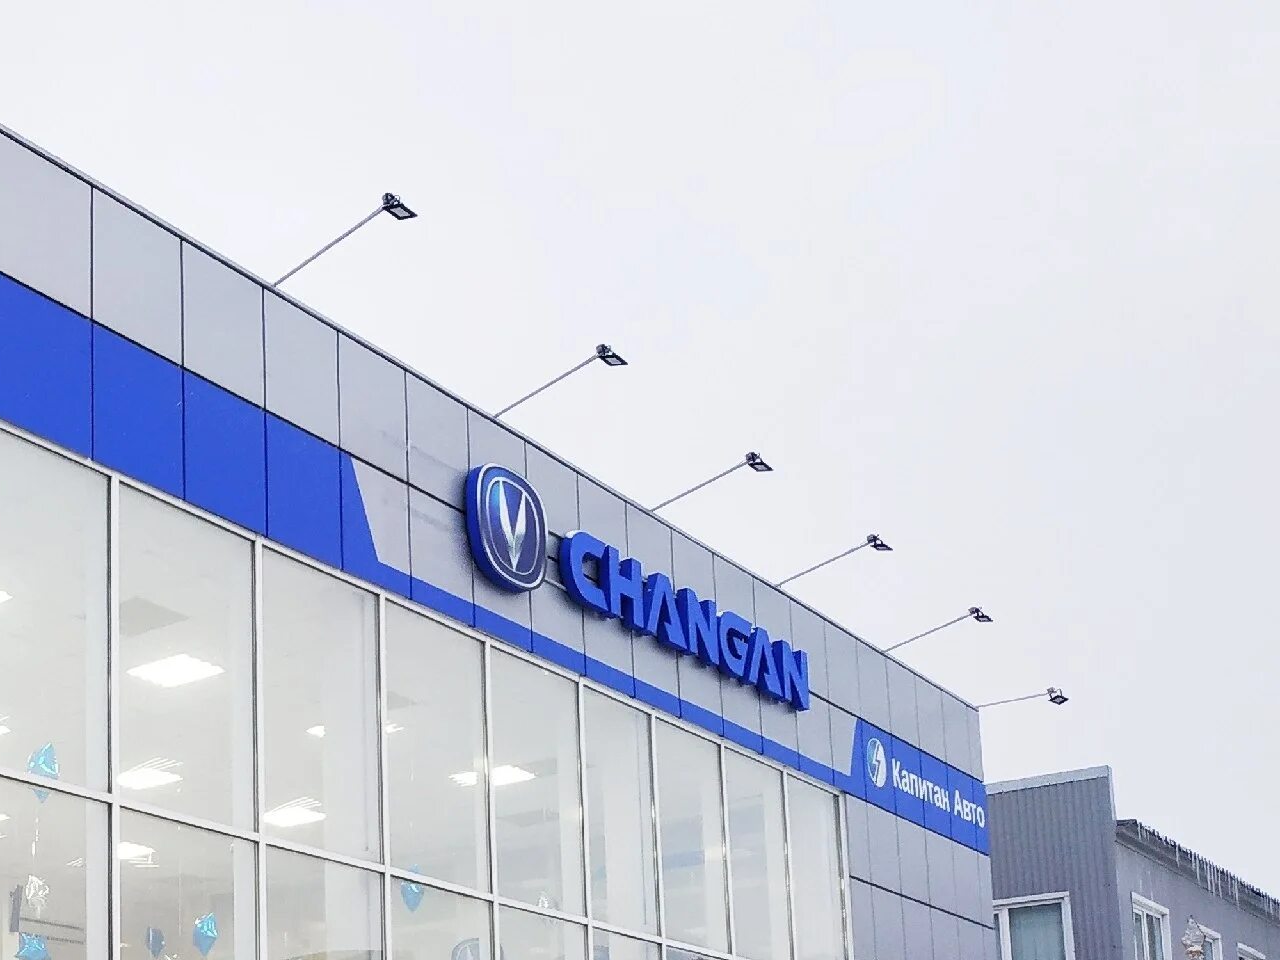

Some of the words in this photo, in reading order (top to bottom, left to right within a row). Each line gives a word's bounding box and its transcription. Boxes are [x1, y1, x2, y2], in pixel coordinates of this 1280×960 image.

[559, 531, 810, 711] CHANGAN
[891, 757, 951, 813] Капитан
[953, 789, 986, 829] Авто
